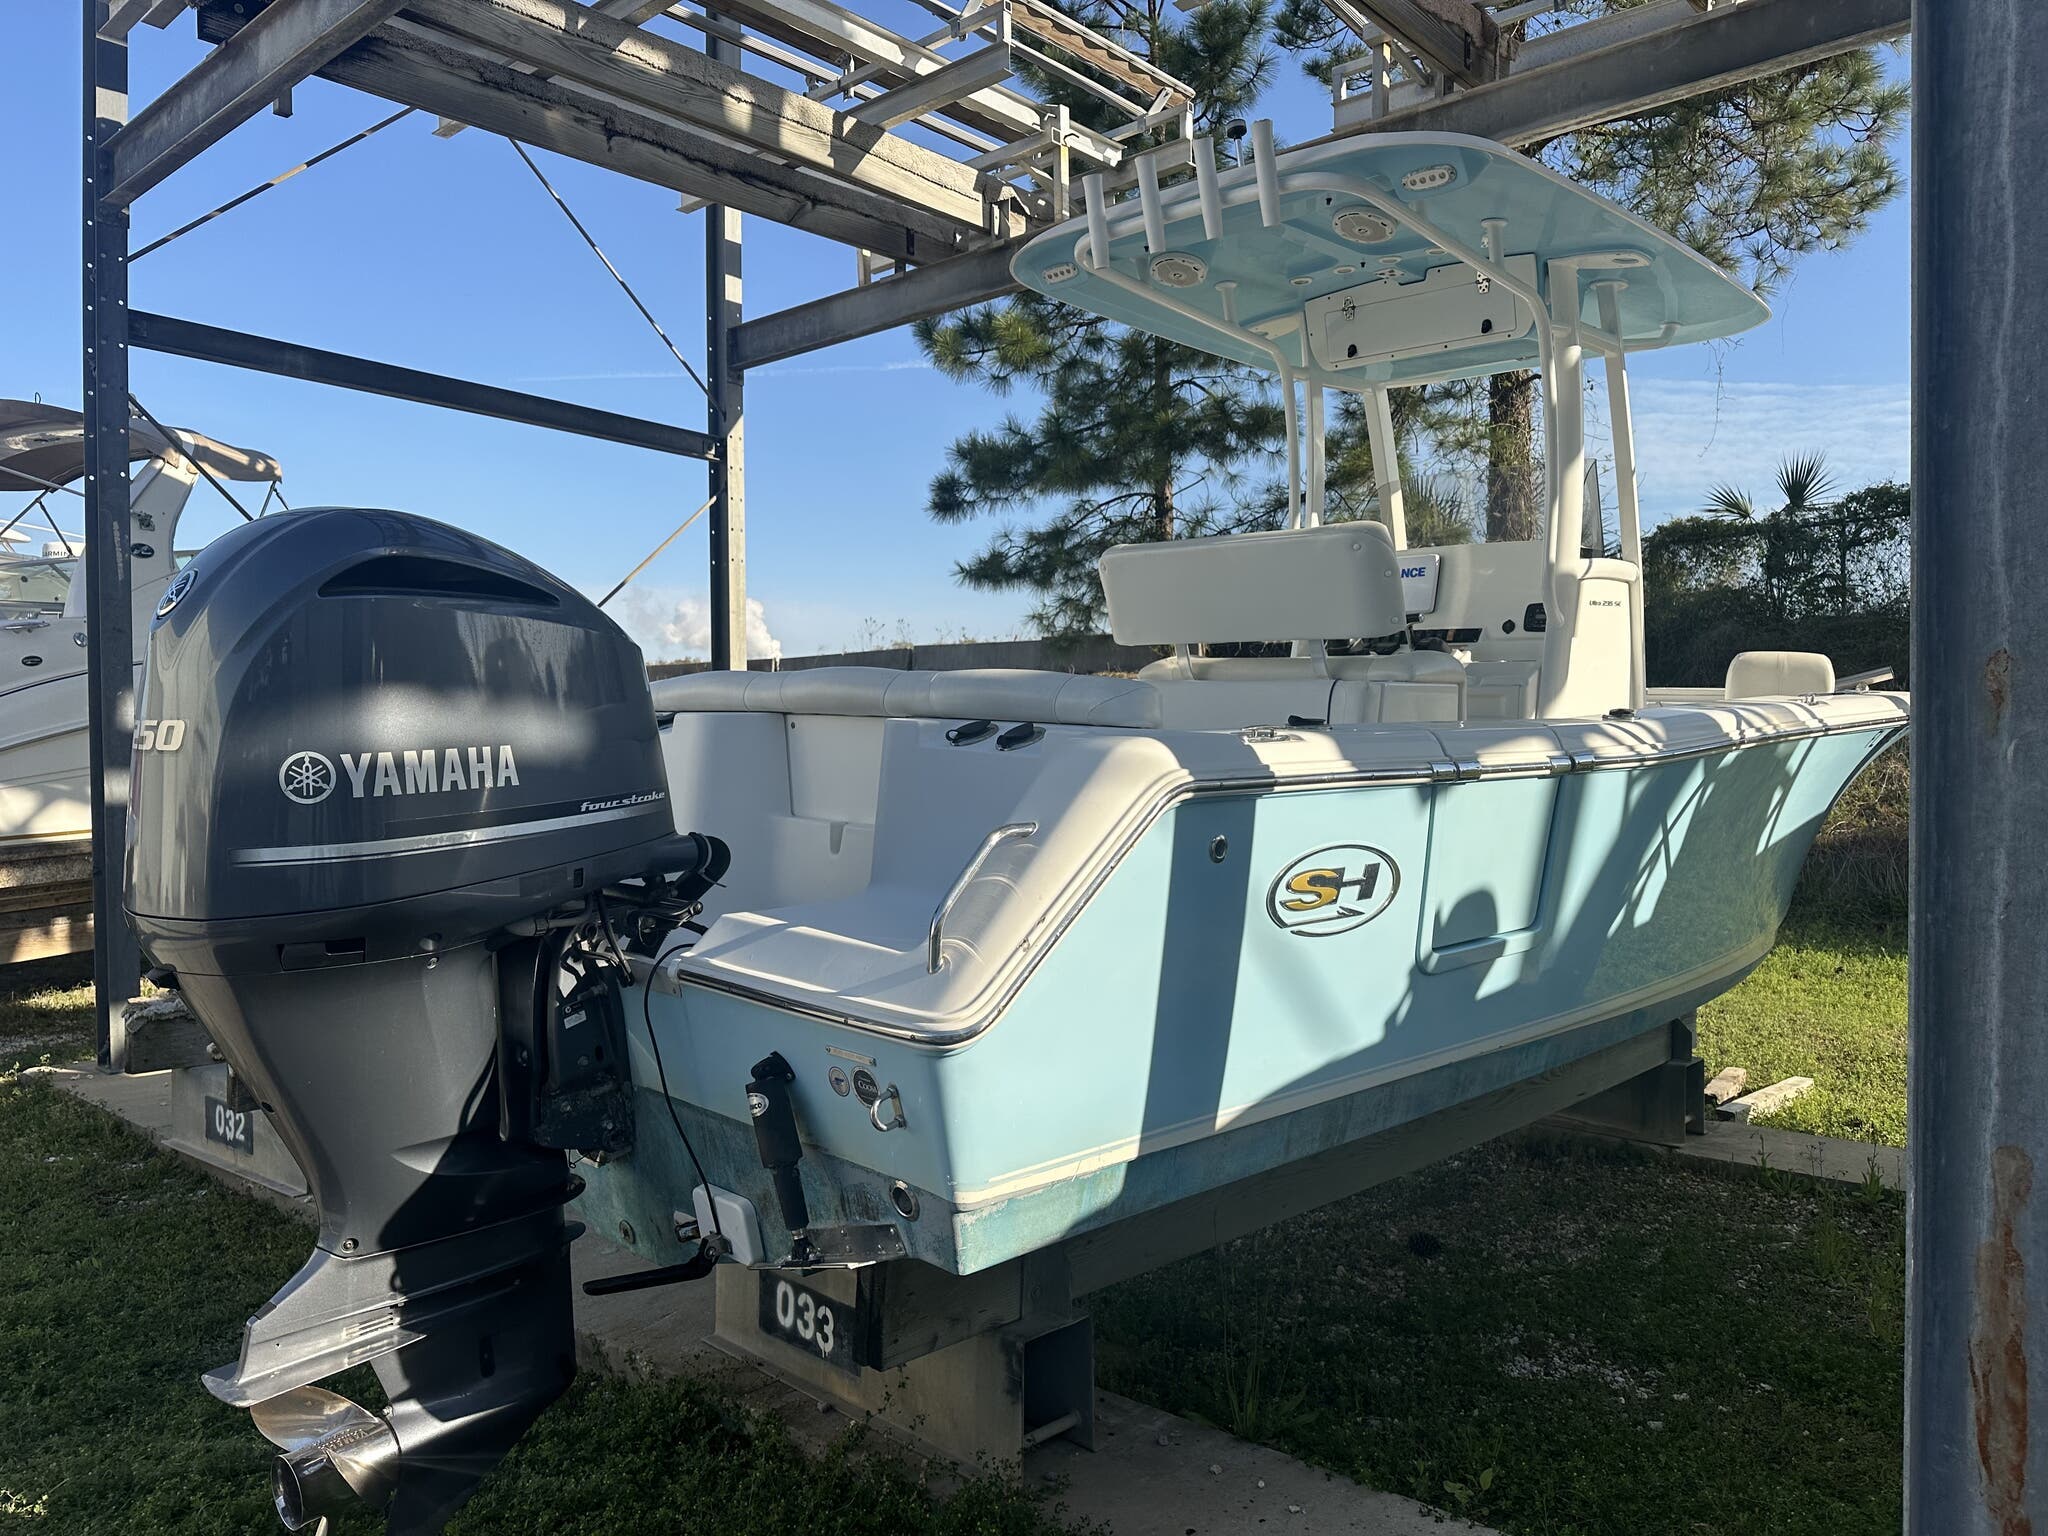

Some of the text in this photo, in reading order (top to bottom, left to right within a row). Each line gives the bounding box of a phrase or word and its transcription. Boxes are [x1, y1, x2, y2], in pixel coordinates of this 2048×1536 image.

[1400, 566, 1426, 578] NCE
[340, 744, 520, 798] YAMAHA
[1279, 862, 1381, 912] SH
[215, 1104, 246, 1141] 032
[776, 1280, 835, 1355] 033
